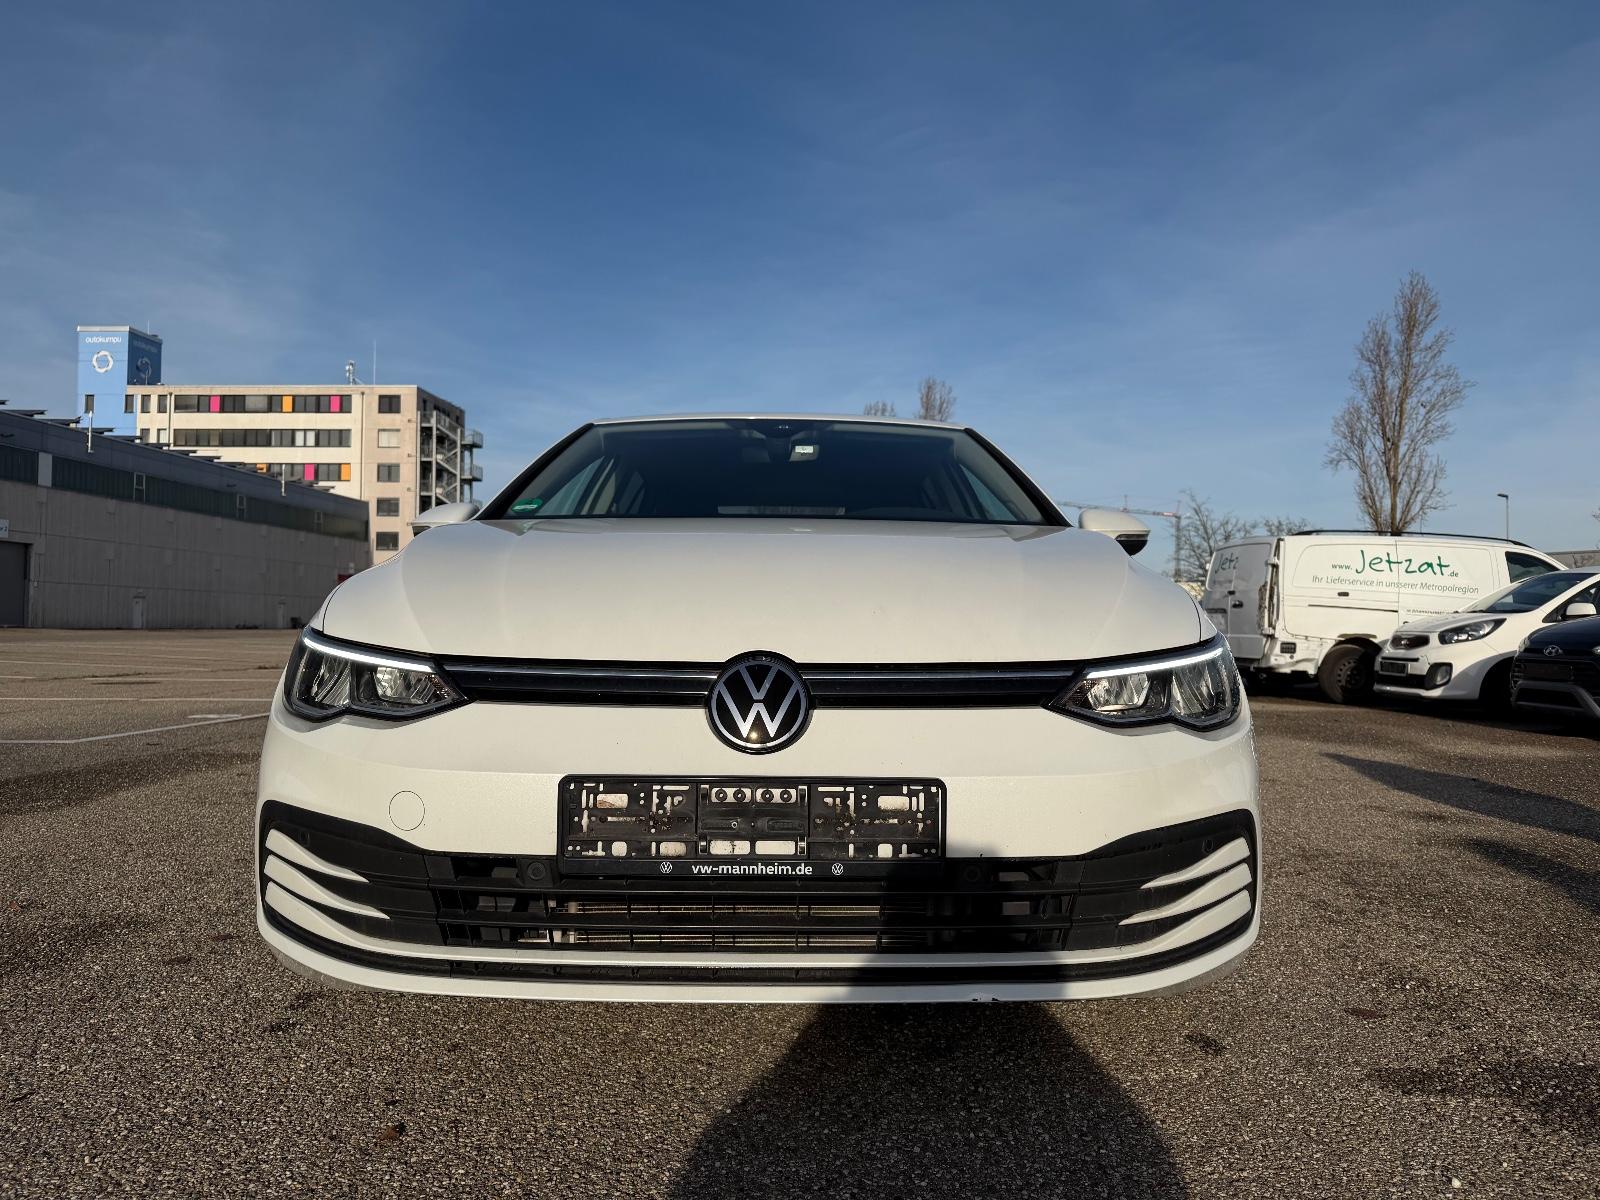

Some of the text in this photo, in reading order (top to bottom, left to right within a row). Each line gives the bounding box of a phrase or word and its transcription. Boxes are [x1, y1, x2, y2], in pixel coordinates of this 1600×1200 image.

[1312, 575, 1323, 583] Ihr
[1326, 576, 1374, 587] Lieferservice
[1376, 579, 1385, 587] in
[692, 863, 812, 875] vw-mannheim.de
